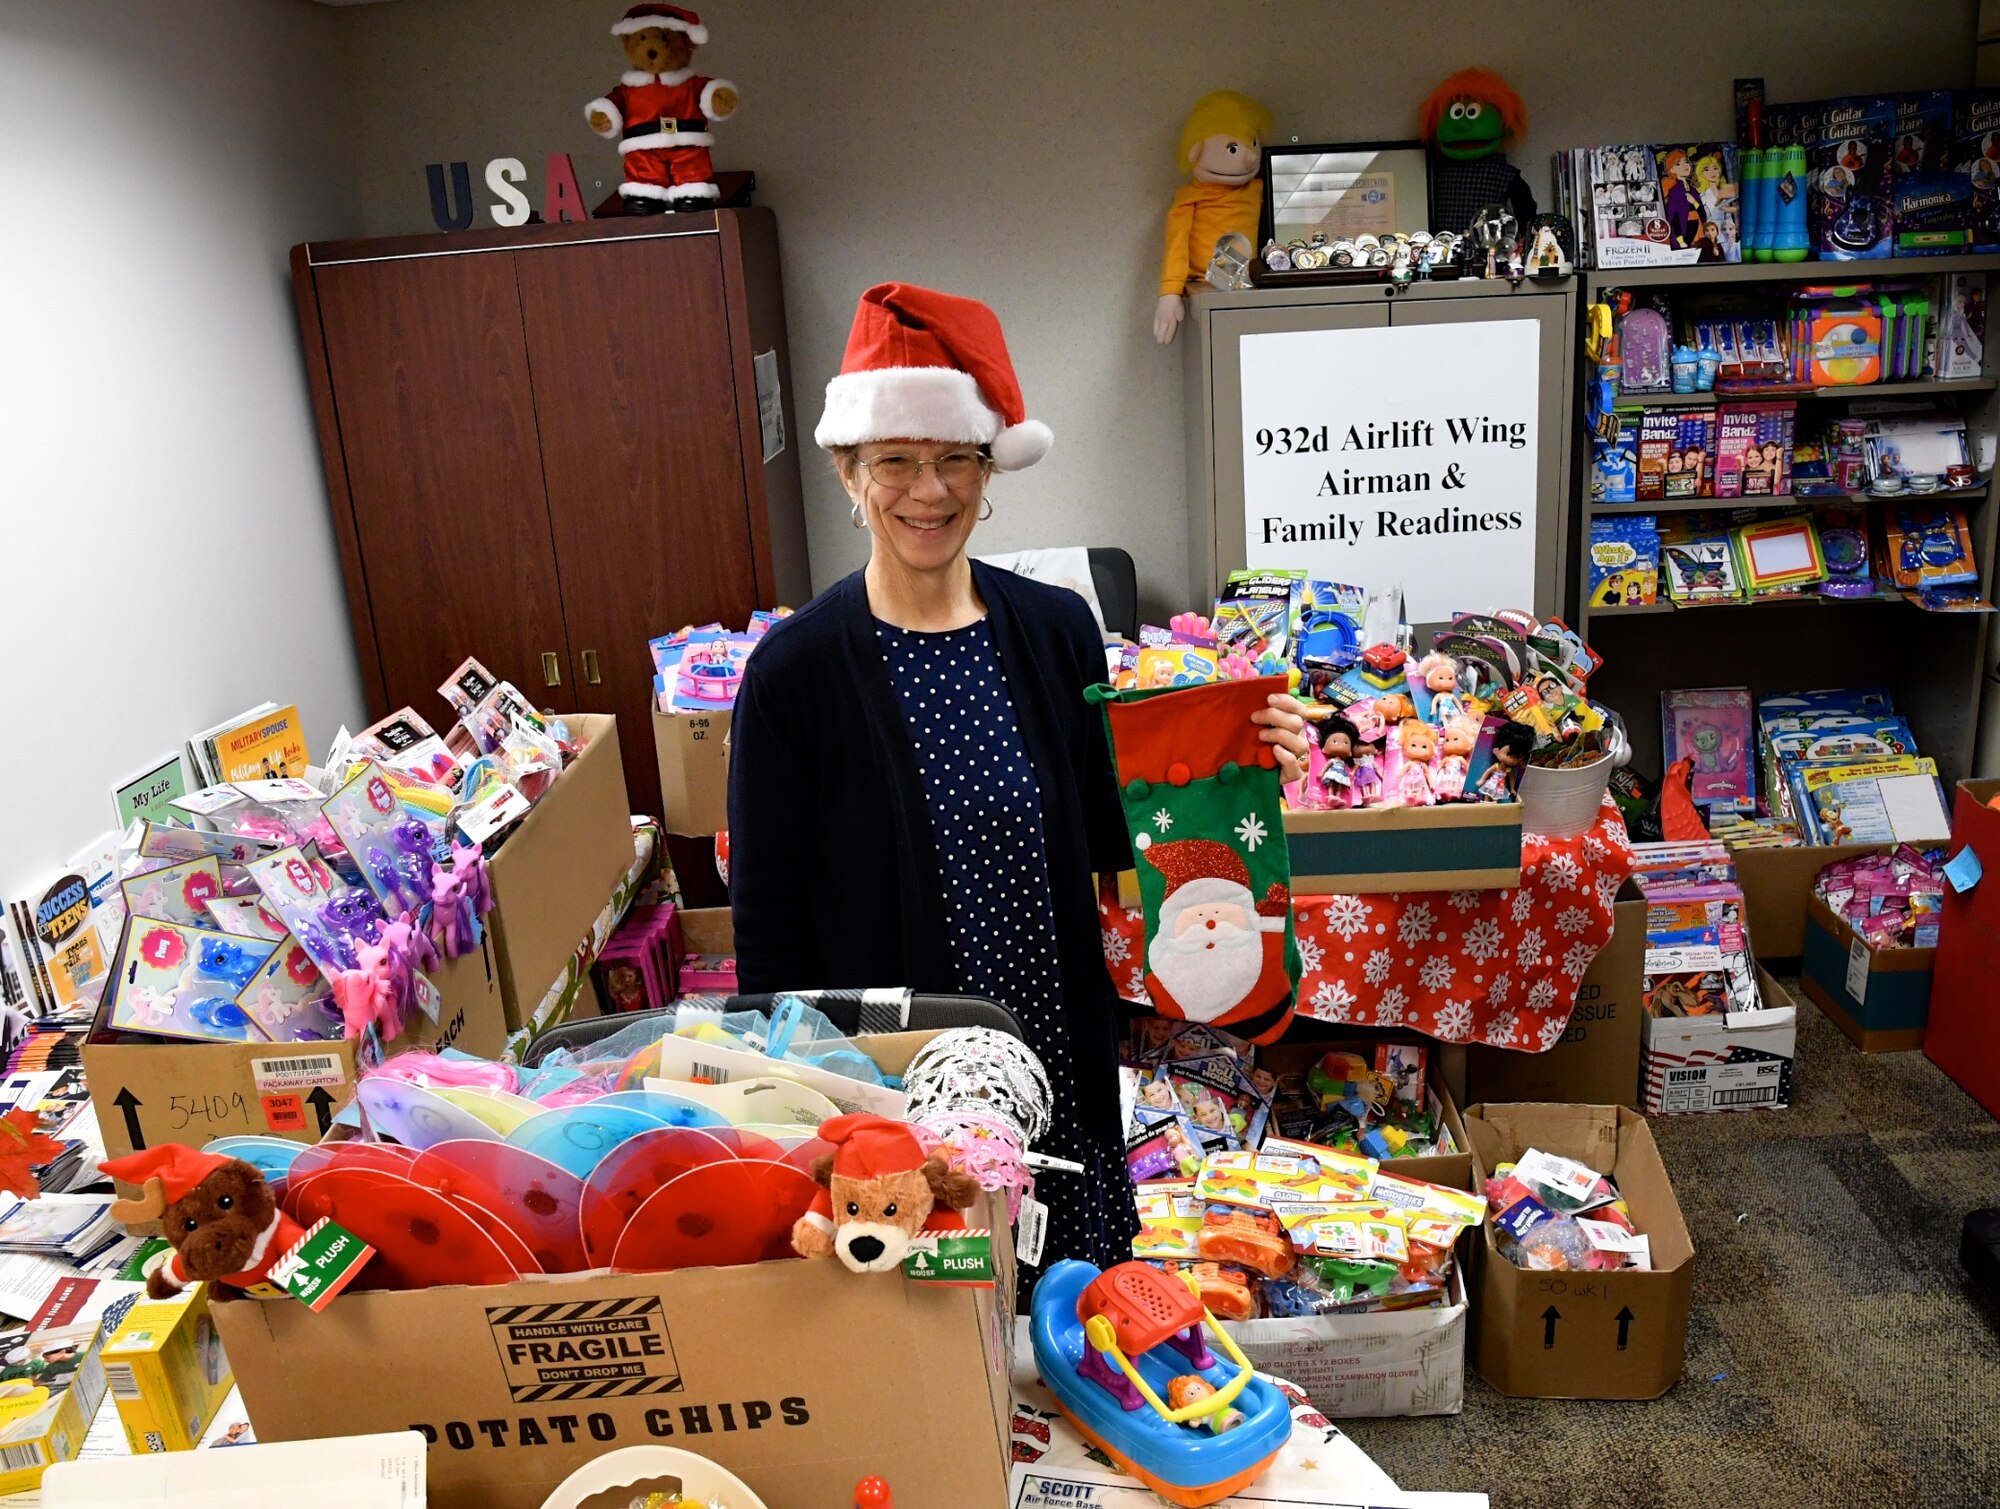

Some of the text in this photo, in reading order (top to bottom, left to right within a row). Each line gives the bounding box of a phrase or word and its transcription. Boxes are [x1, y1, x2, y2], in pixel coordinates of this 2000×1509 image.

[1831, 108, 1864, 124] Guitar
[1829, 124, 1868, 140] Guitare
[1902, 193, 1951, 211] Harmonica
[1605, 246, 1642, 255] FROZEN
[1600, 259, 1622, 268] Velvet
[1623, 259, 1647, 267] Poster
[1643, 415, 1678, 428] Invite
[1723, 413, 1757, 425] Invite
[1256, 416, 1527, 456] 932d Airlift Wing
[1641, 429, 1678, 441] Bandz
[1721, 426, 1757, 438] Bandz
[1316, 462, 1467, 498] Airman &
[1260, 507, 1523, 546] Family Readiness
[1594, 545, 1625, 554] What
[1248, 576, 1292, 587] GLIDERS
[1234, 586, 1289, 597] PLANEURS
[231, 719, 288, 752] MILITARYSPOUSE
[132, 779, 171, 809] My Life
[37, 880, 86, 924] SUCCESS
[48, 896, 90, 939] TEENS
[65, 935, 88, 959] Teens
[155, 939, 171, 959] Pony
[63, 953, 81, 973] Talk
[1669, 1069, 1707, 1082] VISION
[1757, 1064, 1779, 1074] BSC
[263, 1077, 338, 1088] PACKAWAY CARTON
[168, 1092, 251, 1130] 5409
[268, 1098, 293, 1108] 3047
[315, 1235, 350, 1269] PLUSH
[943, 1257, 984, 1270] PLUSH
[514, 1319, 644, 1338] HANDLE WITH CARE
[507, 1334, 666, 1366] FRAGILE
[1274, 1360, 1309, 1368] GLOVES
[1331, 1357, 1361, 1365] BOXES
[541, 1364, 642, 1381] DON'T DROP ME
[1335, 1372, 1387, 1382] EXAMINATION
[1388, 1369, 1420, 1378] GLOVES
[1320, 1382, 1345, 1390] LATEX
[407, 1396, 811, 1453] POTATO CHIPS
[1039, 1481, 1094, 1499] SCOTT
[1025, 1494, 1101, 1509] Air Force Base
